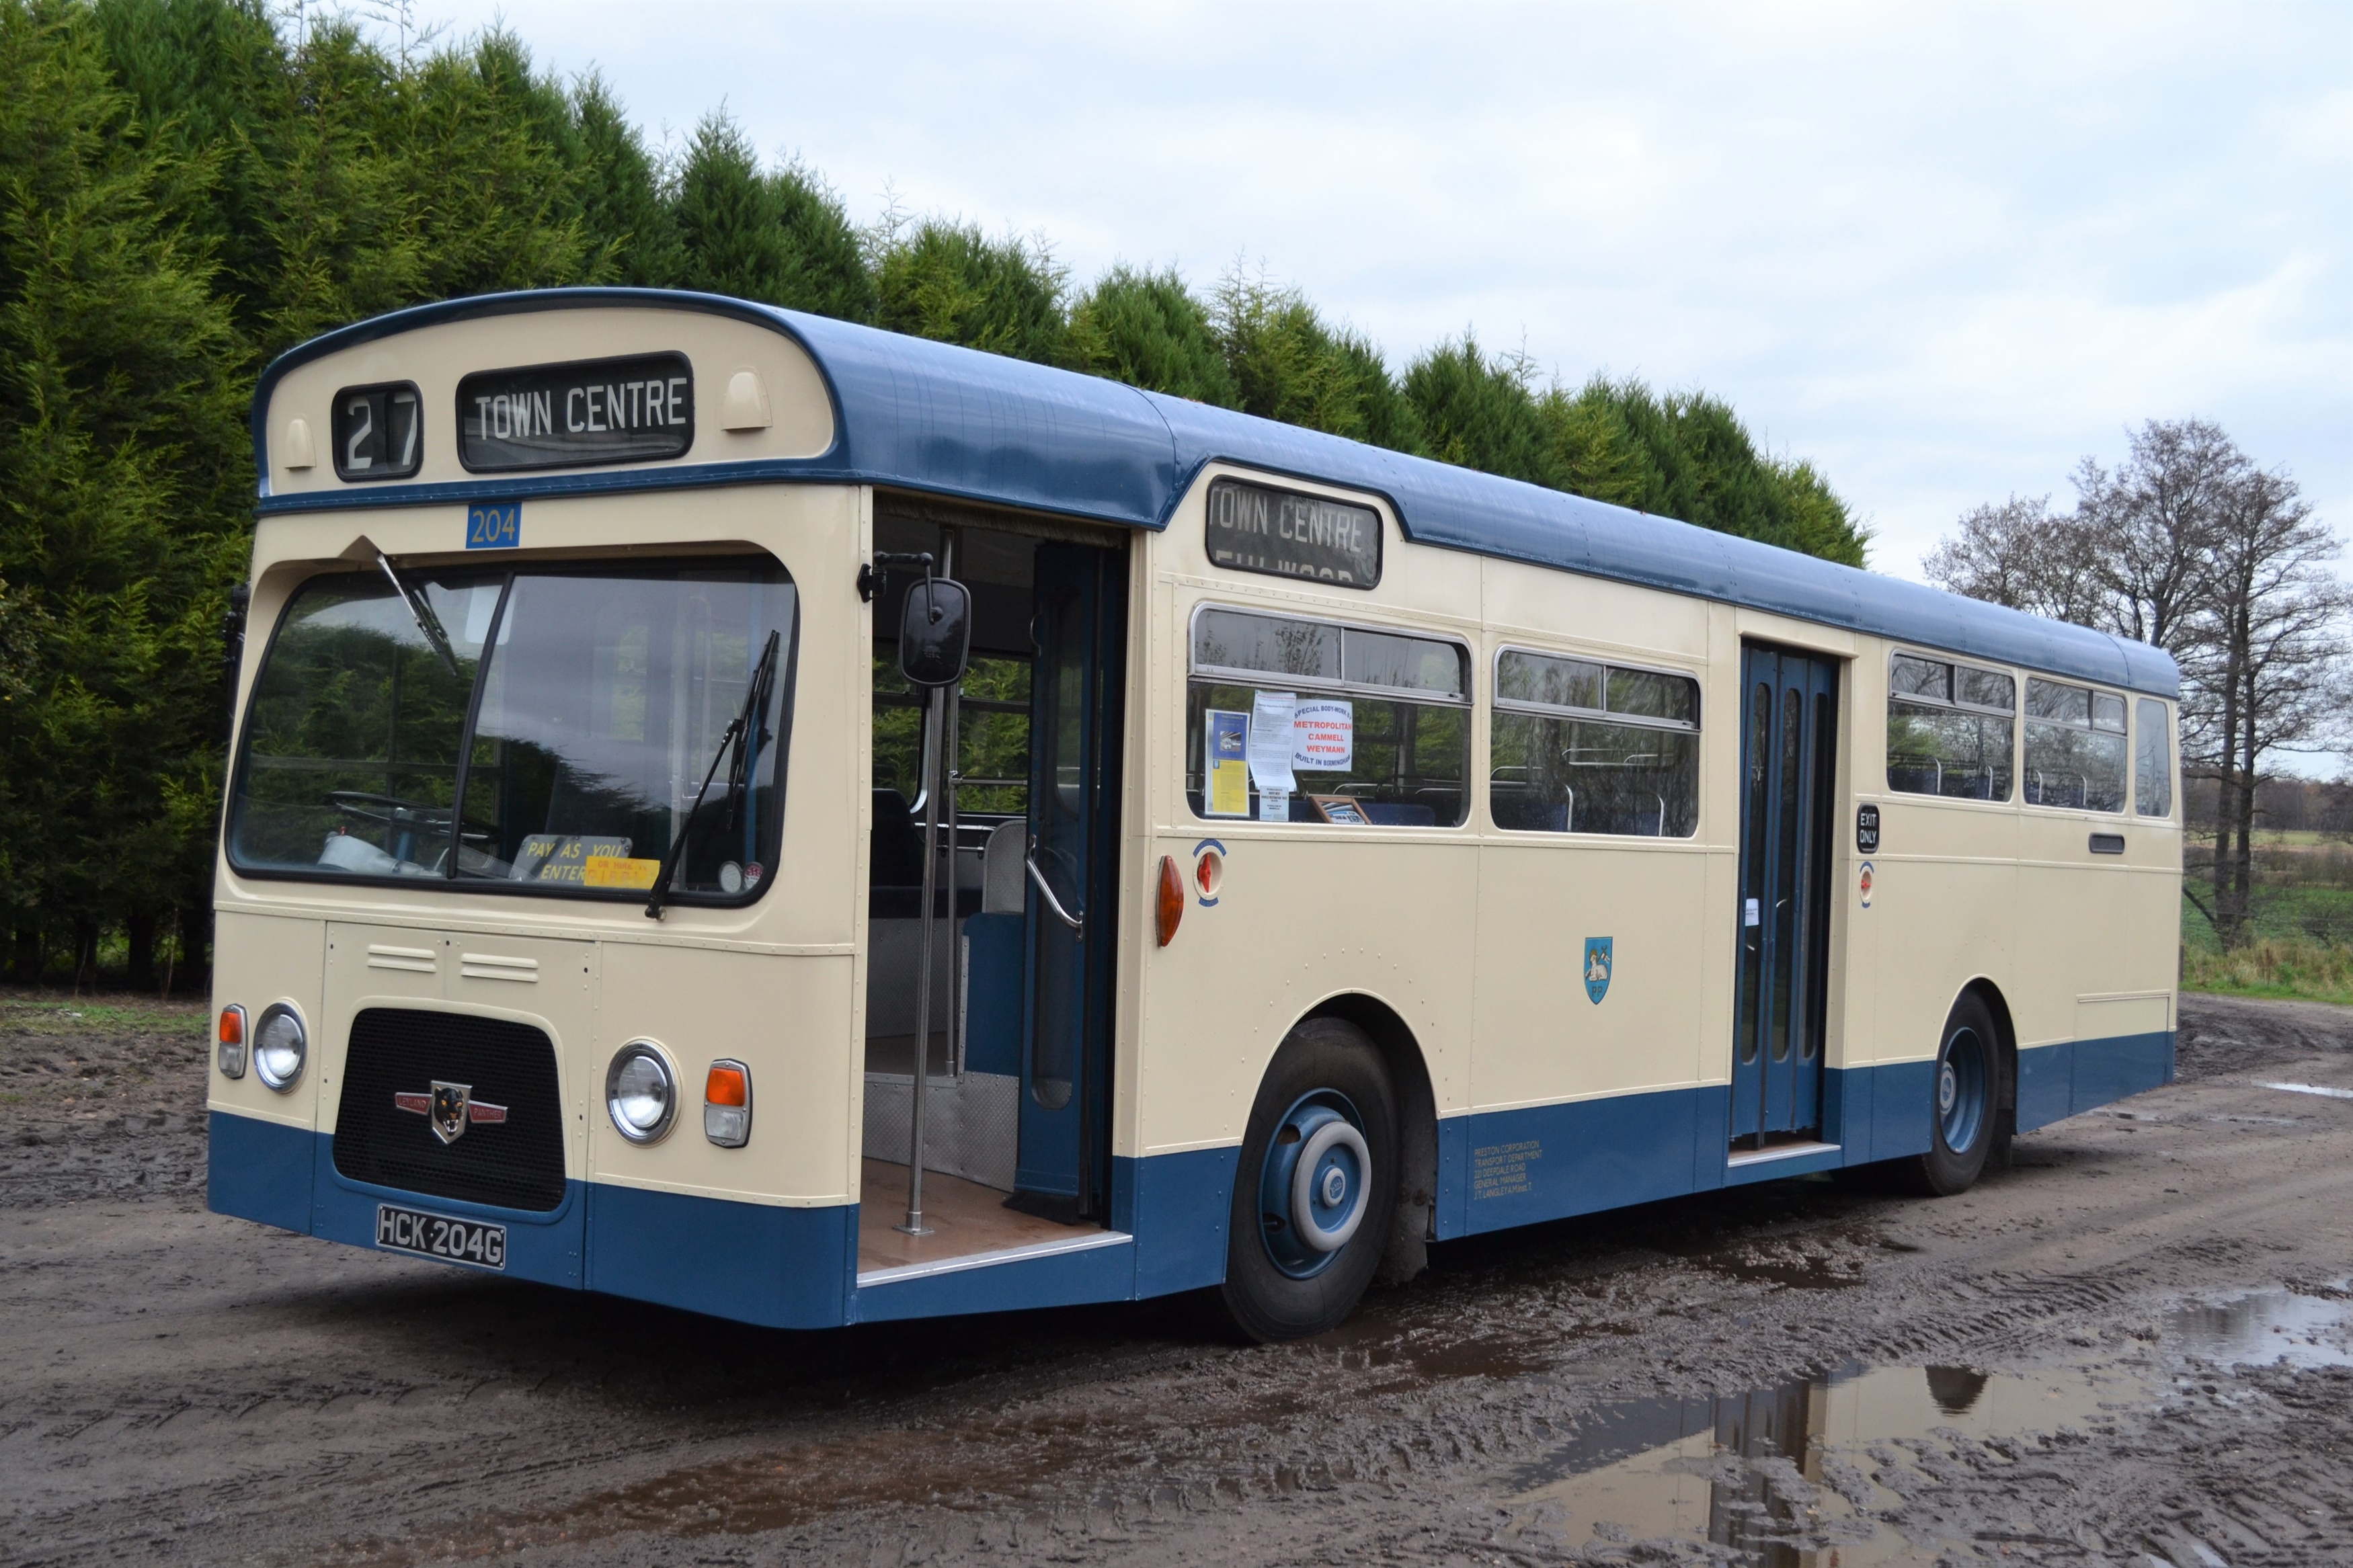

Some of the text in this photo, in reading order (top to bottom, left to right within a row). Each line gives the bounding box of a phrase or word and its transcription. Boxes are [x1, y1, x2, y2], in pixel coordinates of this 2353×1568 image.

[475, 378, 687, 440] TOWN CENTRE
[471, 509, 515, 542] 204
[1279, 500, 1363, 552] CENTRE
[1294, 706, 1320, 718] SPECIAL
[1293, 721, 1352, 730] METROPOLITAN
[1308, 733, 1344, 741] CAMMELL
[1307, 745, 1345, 753] WEYMANN
[1295, 752, 1314, 764] BUILT
[1860, 813, 1877, 827] EXIT
[1860, 829, 1877, 843] ONLY
[527, 842, 622, 858] PAY AS YOU
[541, 864, 586, 881] ENTER
[399, 1098, 426, 1108] LEYLAND
[474, 1108, 502, 1119] PANTHER
[1474, 1141, 1539, 1156] PRESTON CORPORATION
[1474, 1150, 1542, 1167] TRANSPORT DEPARTMENT
[1482, 1166, 1509, 1177] DEEPDALE
[1511, 1163, 1525, 1173] ROAD
[1474, 1173, 1526, 1189] GENERAL MANAGER
[379, 1210, 502, 1263] HCK 204G
